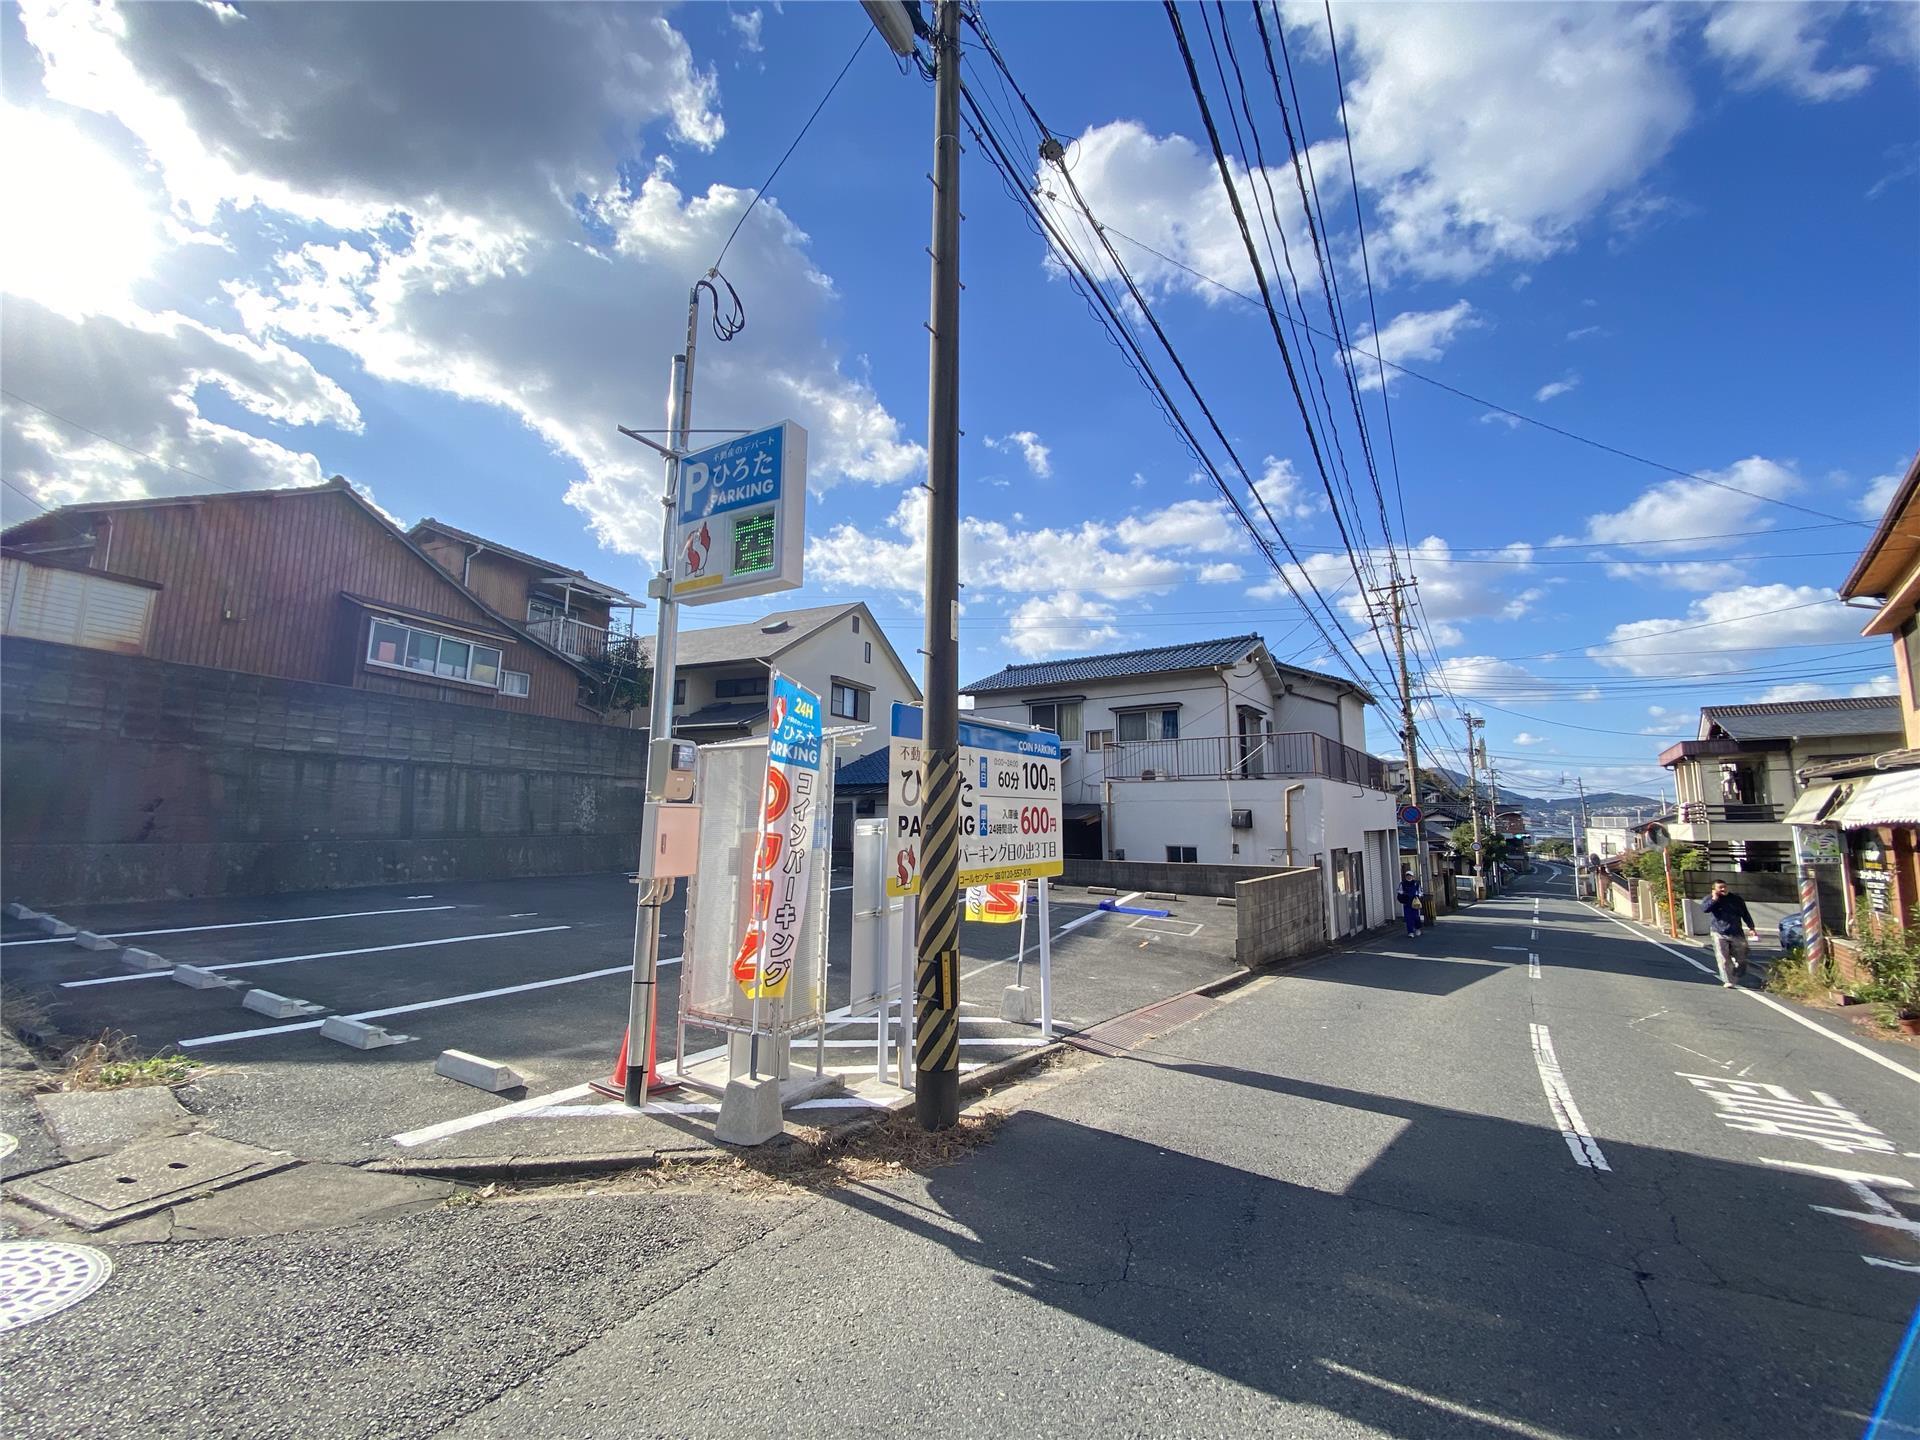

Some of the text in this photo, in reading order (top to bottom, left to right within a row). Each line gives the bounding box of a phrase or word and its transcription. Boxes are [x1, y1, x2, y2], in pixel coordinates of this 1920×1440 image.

[713, 450, 773, 488] ひろた
[684, 462, 710, 513] P
[711, 478, 774, 507] PARKING
[794, 697, 814, 720] 24H
[784, 725, 818, 748] ひろた
[1018, 741, 1057, 756] COIN PARKING
[771, 740, 818, 764] ARKING
[998, 762, 1056, 792] 60分 100円
[1021, 806, 1057, 835] 600円
[764, 772, 814, 988] コインパーキング
